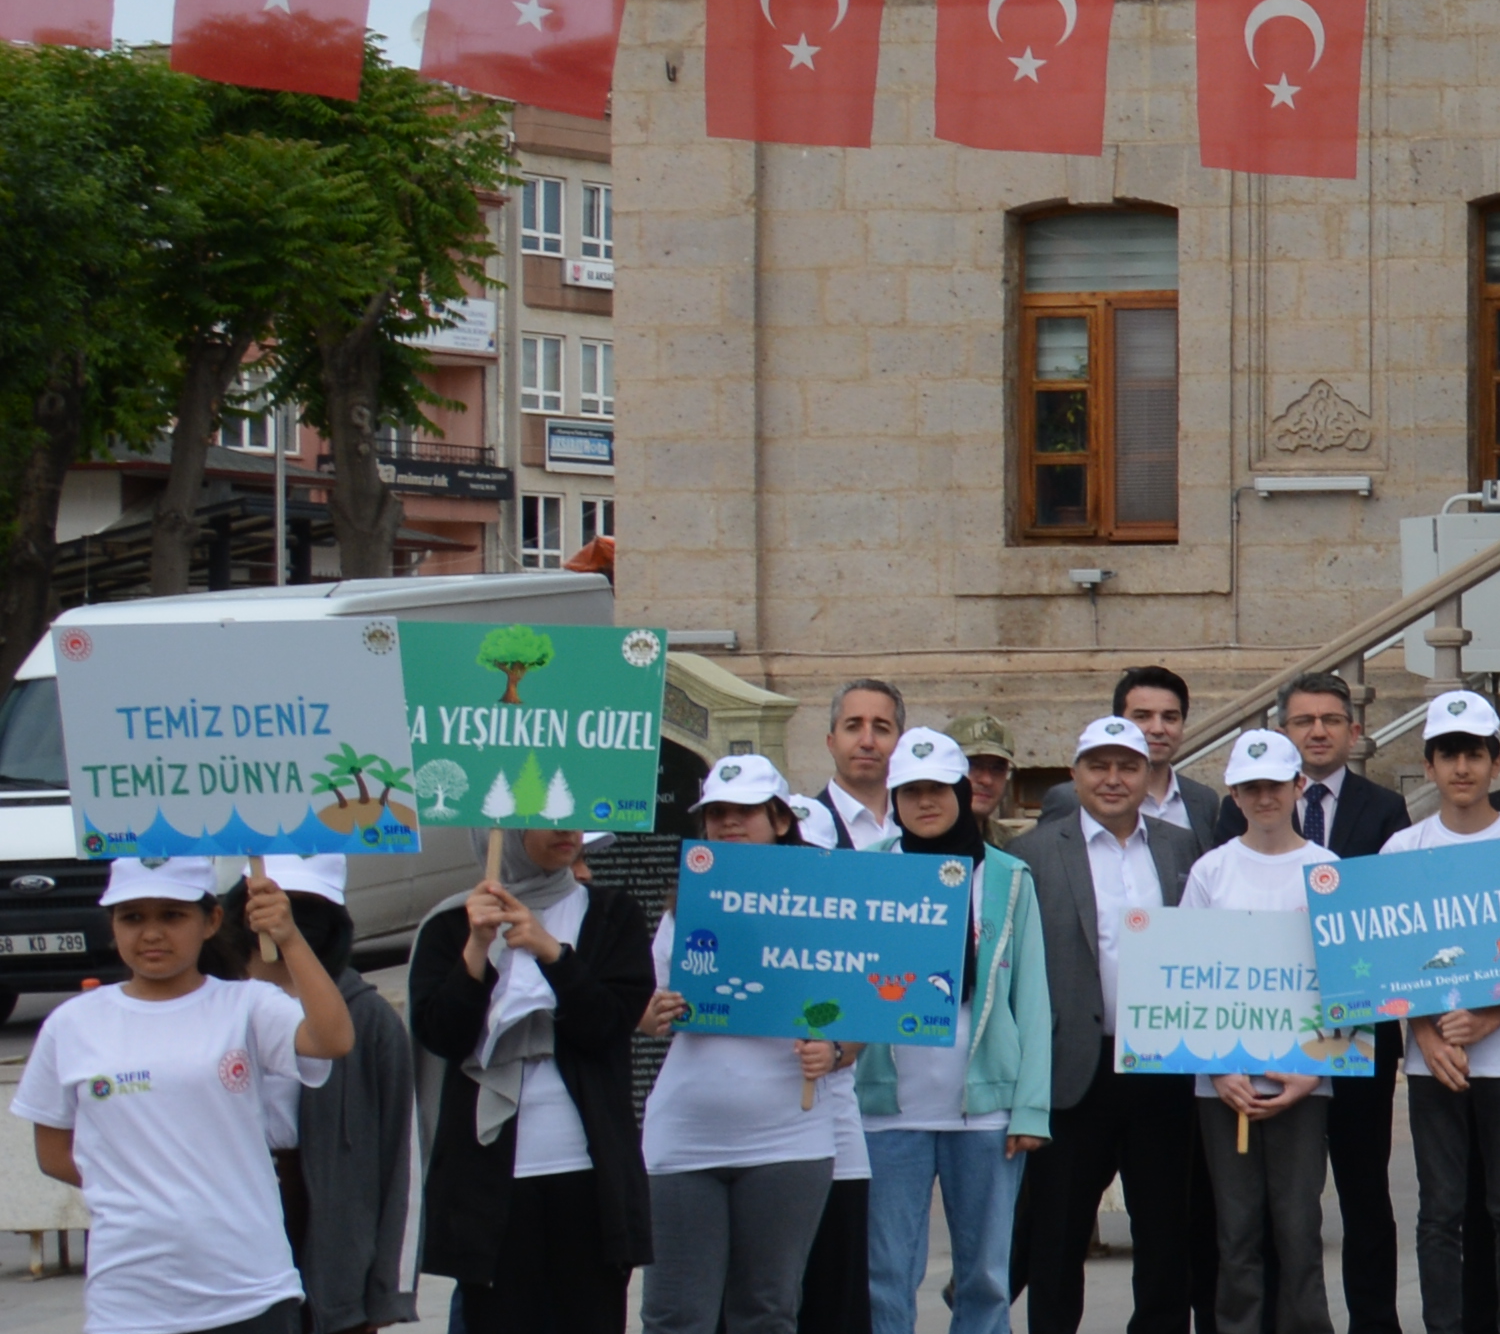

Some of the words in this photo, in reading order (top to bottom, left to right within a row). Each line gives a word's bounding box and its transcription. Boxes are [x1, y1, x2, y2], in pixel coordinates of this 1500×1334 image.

[116, 698, 224, 739] TEMİZ
[233, 695, 332, 738] DENİZ
[439, 703, 569, 752] YEŞİLKEN
[577, 706, 656, 751] GÜZEL
[81, 756, 191, 799] TEMİZ
[199, 755, 304, 795] DÜNYA
[865, 896, 948, 926] TEMİZ
[1315, 912, 1346, 947] SU
[1350, 901, 1428, 942] VARSA
[28, 936, 47, 952] KD
[57, 934, 83, 951] 289
[1160, 961, 1240, 990] TEMİZ
[1247, 962, 1319, 992] DENİZ
[1127, 1000, 1209, 1030] TEMİZ
[1215, 1001, 1294, 1032] DÜNYA
[116, 1070, 151, 1084] SIFIR
